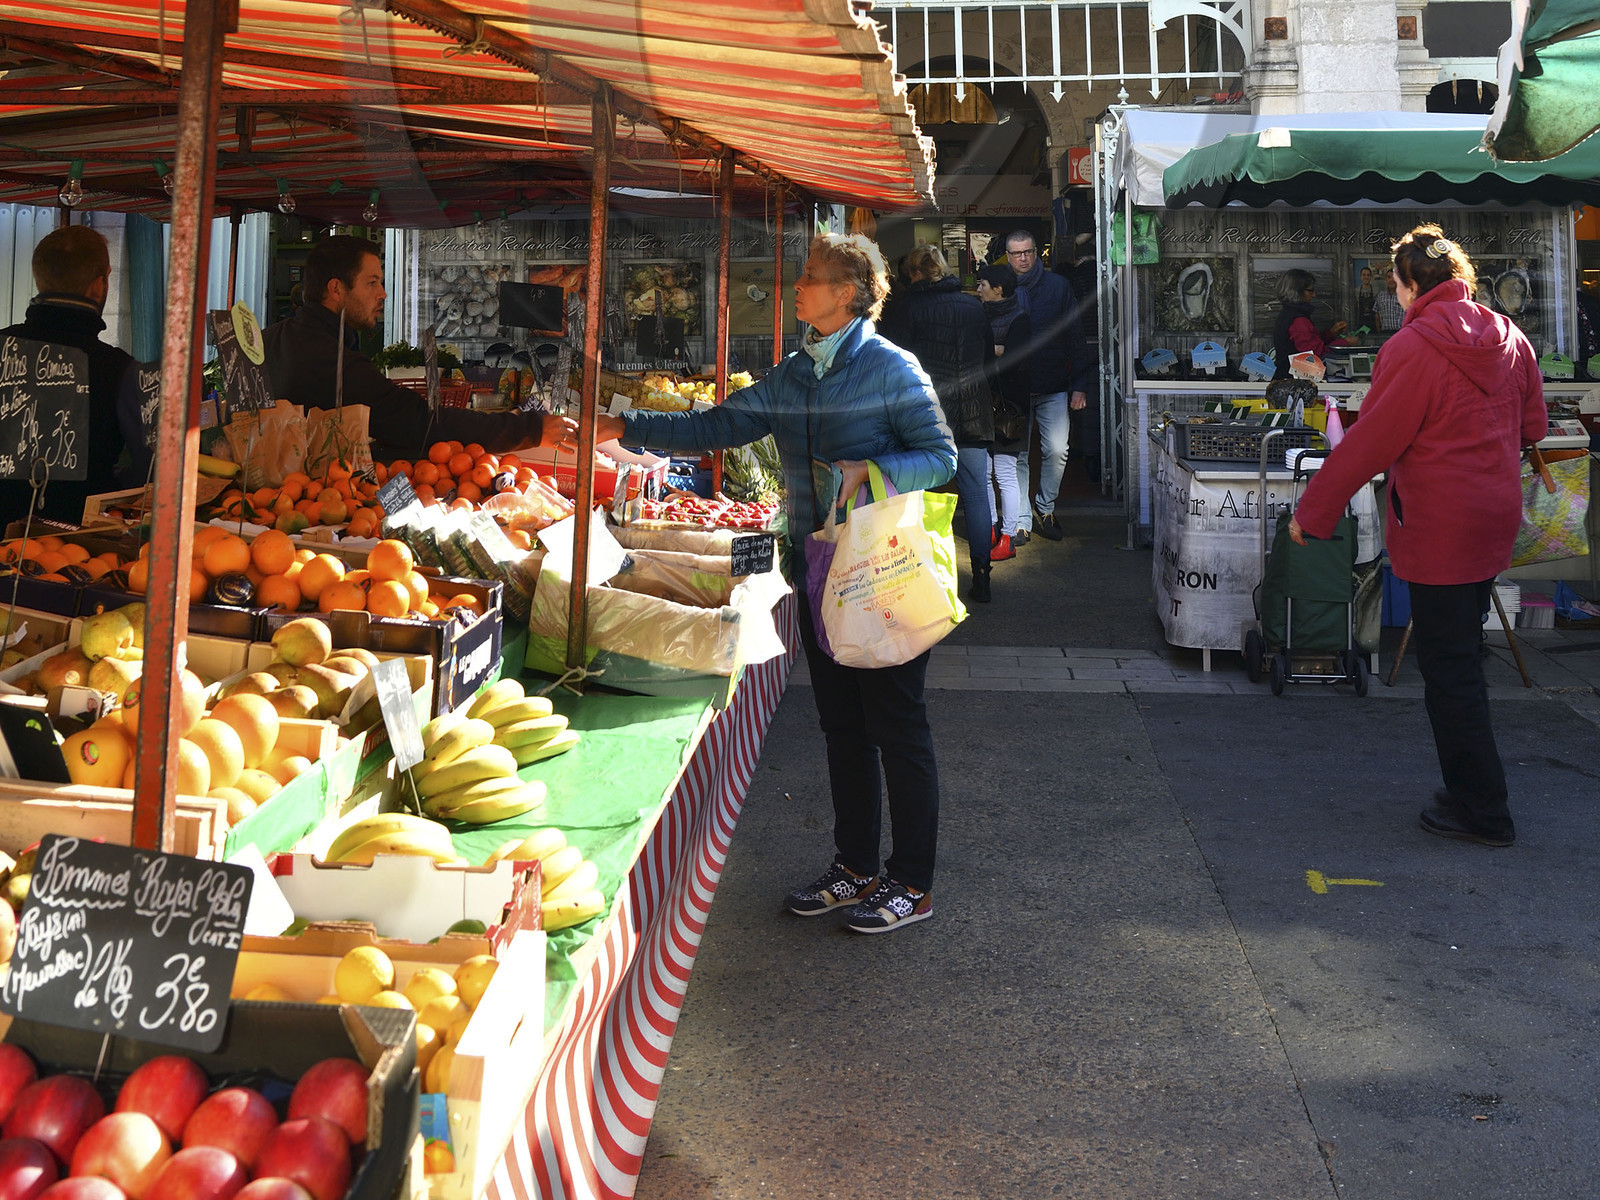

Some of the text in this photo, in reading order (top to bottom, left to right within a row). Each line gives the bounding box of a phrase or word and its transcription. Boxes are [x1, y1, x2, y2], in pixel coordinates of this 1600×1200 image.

[498, 235, 557, 250] Roland
[1218, 227, 1286, 243] Roland
[1506, 227, 1542, 245] Fils
[615, 359, 653, 371] arennes
[31, 836, 131, 899] Pommes
